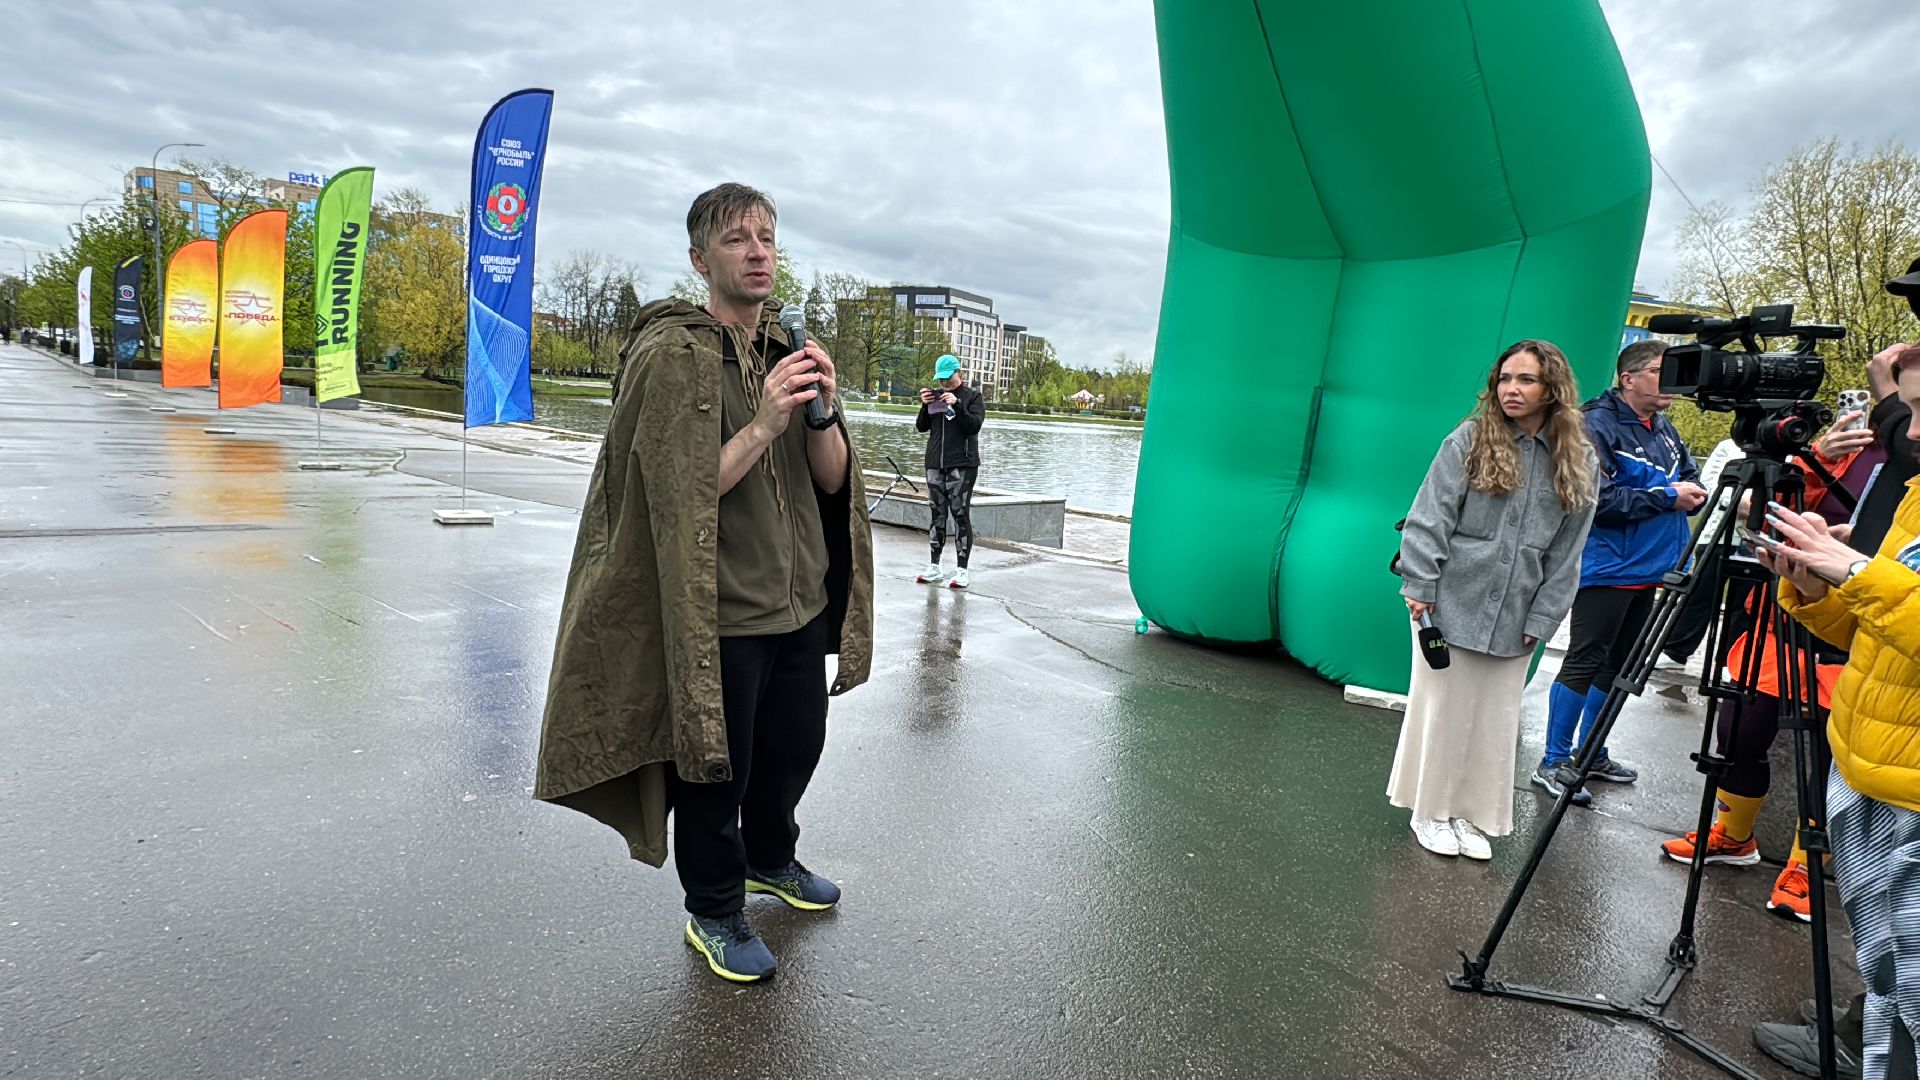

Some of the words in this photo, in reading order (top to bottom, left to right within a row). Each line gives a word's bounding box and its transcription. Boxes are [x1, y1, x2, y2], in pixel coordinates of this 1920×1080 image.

[501, 138, 521, 149] СОЮЗ
[496, 156, 525, 168] РОССИИ
[288, 171, 321, 185] park
[332, 221, 361, 345] RUNNING
[492, 273, 513, 284] ОКРУГ
